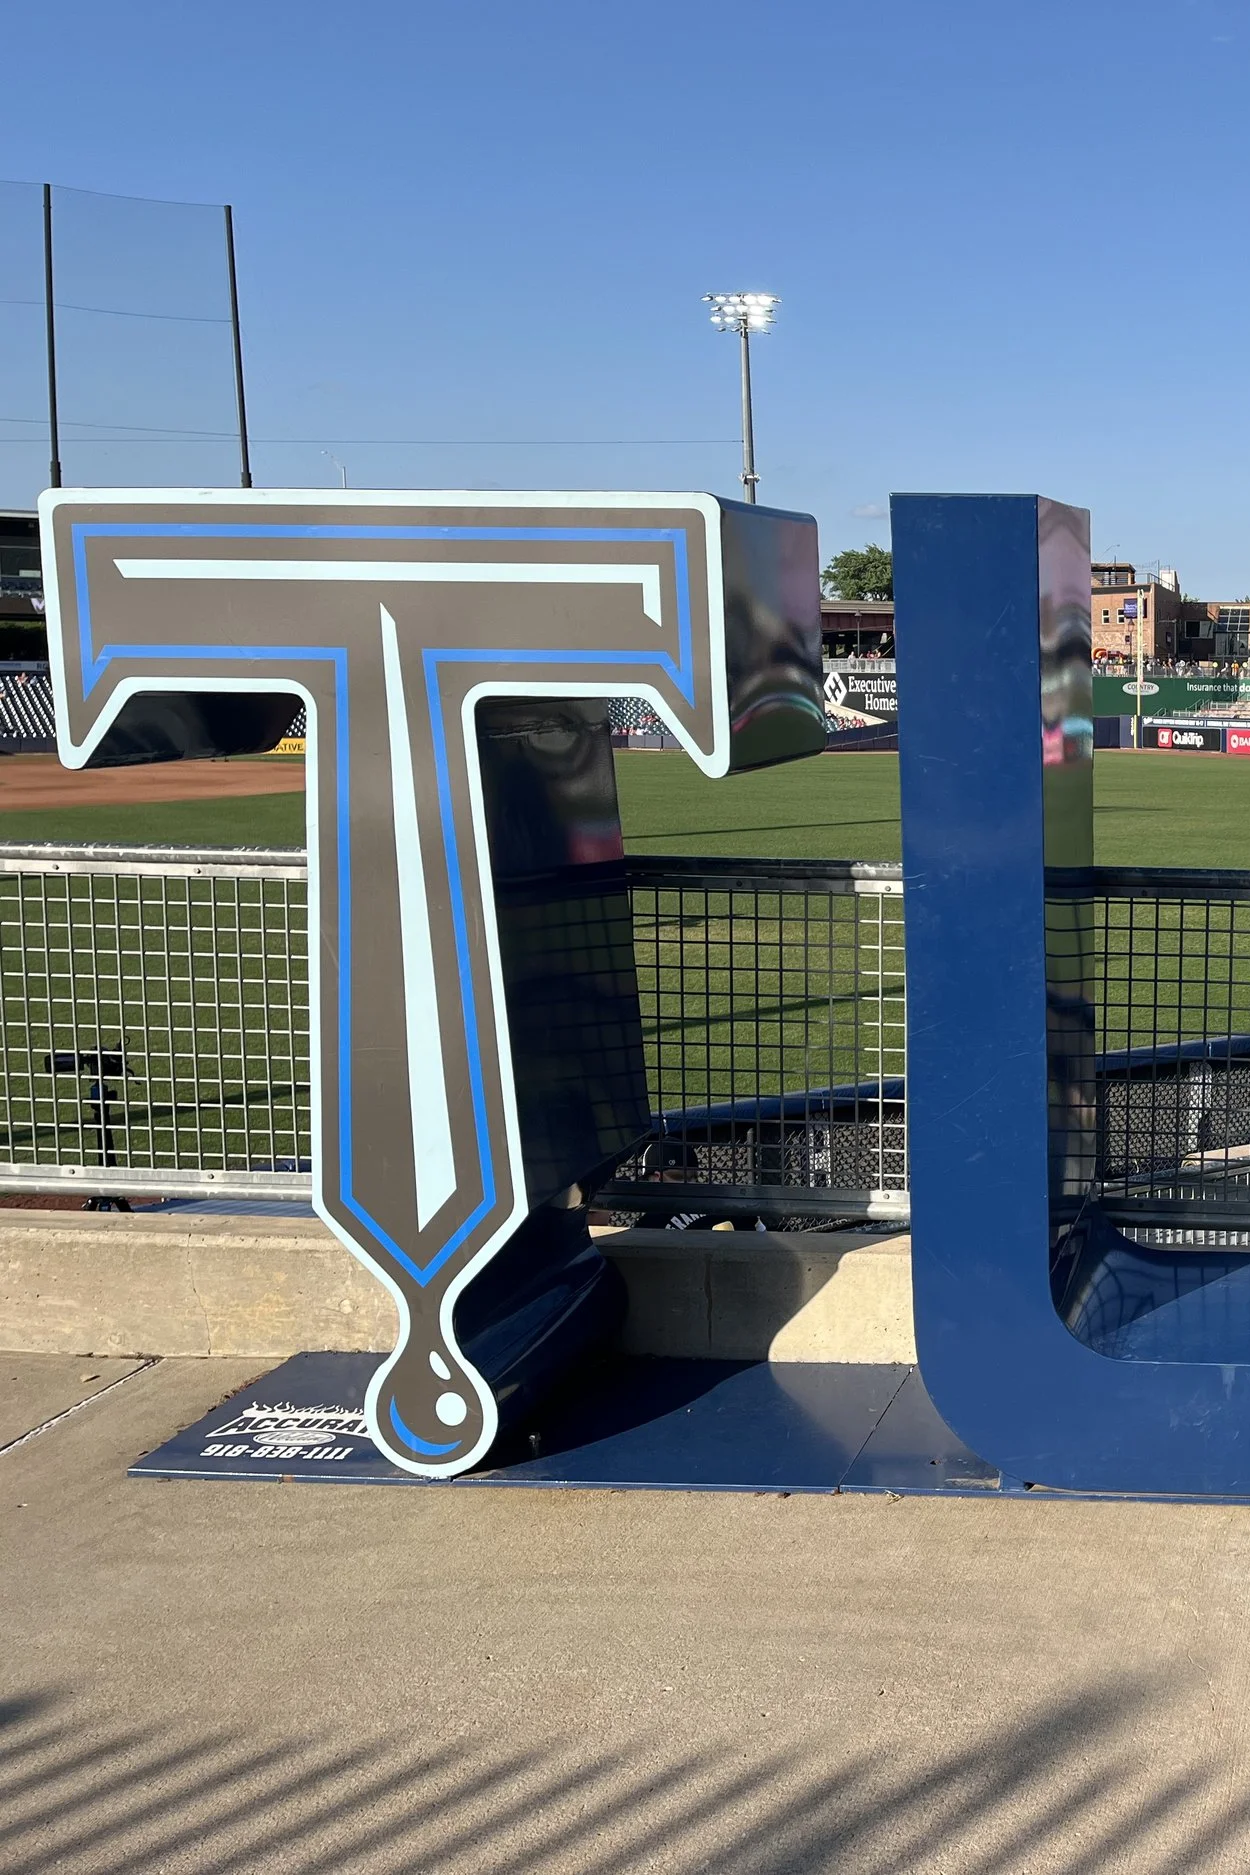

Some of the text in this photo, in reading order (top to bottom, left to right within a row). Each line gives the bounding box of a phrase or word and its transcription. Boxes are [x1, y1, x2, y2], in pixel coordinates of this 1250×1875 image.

[848, 675, 897, 693] Executive
[1186, 682, 1222, 692] Insurance
[1223, 683, 1238, 692] that
[273, 743, 304, 752] ATIVE
[1172, 731, 1204, 748] QuikTrip
[216, 1416, 370, 1434] ACCURA
